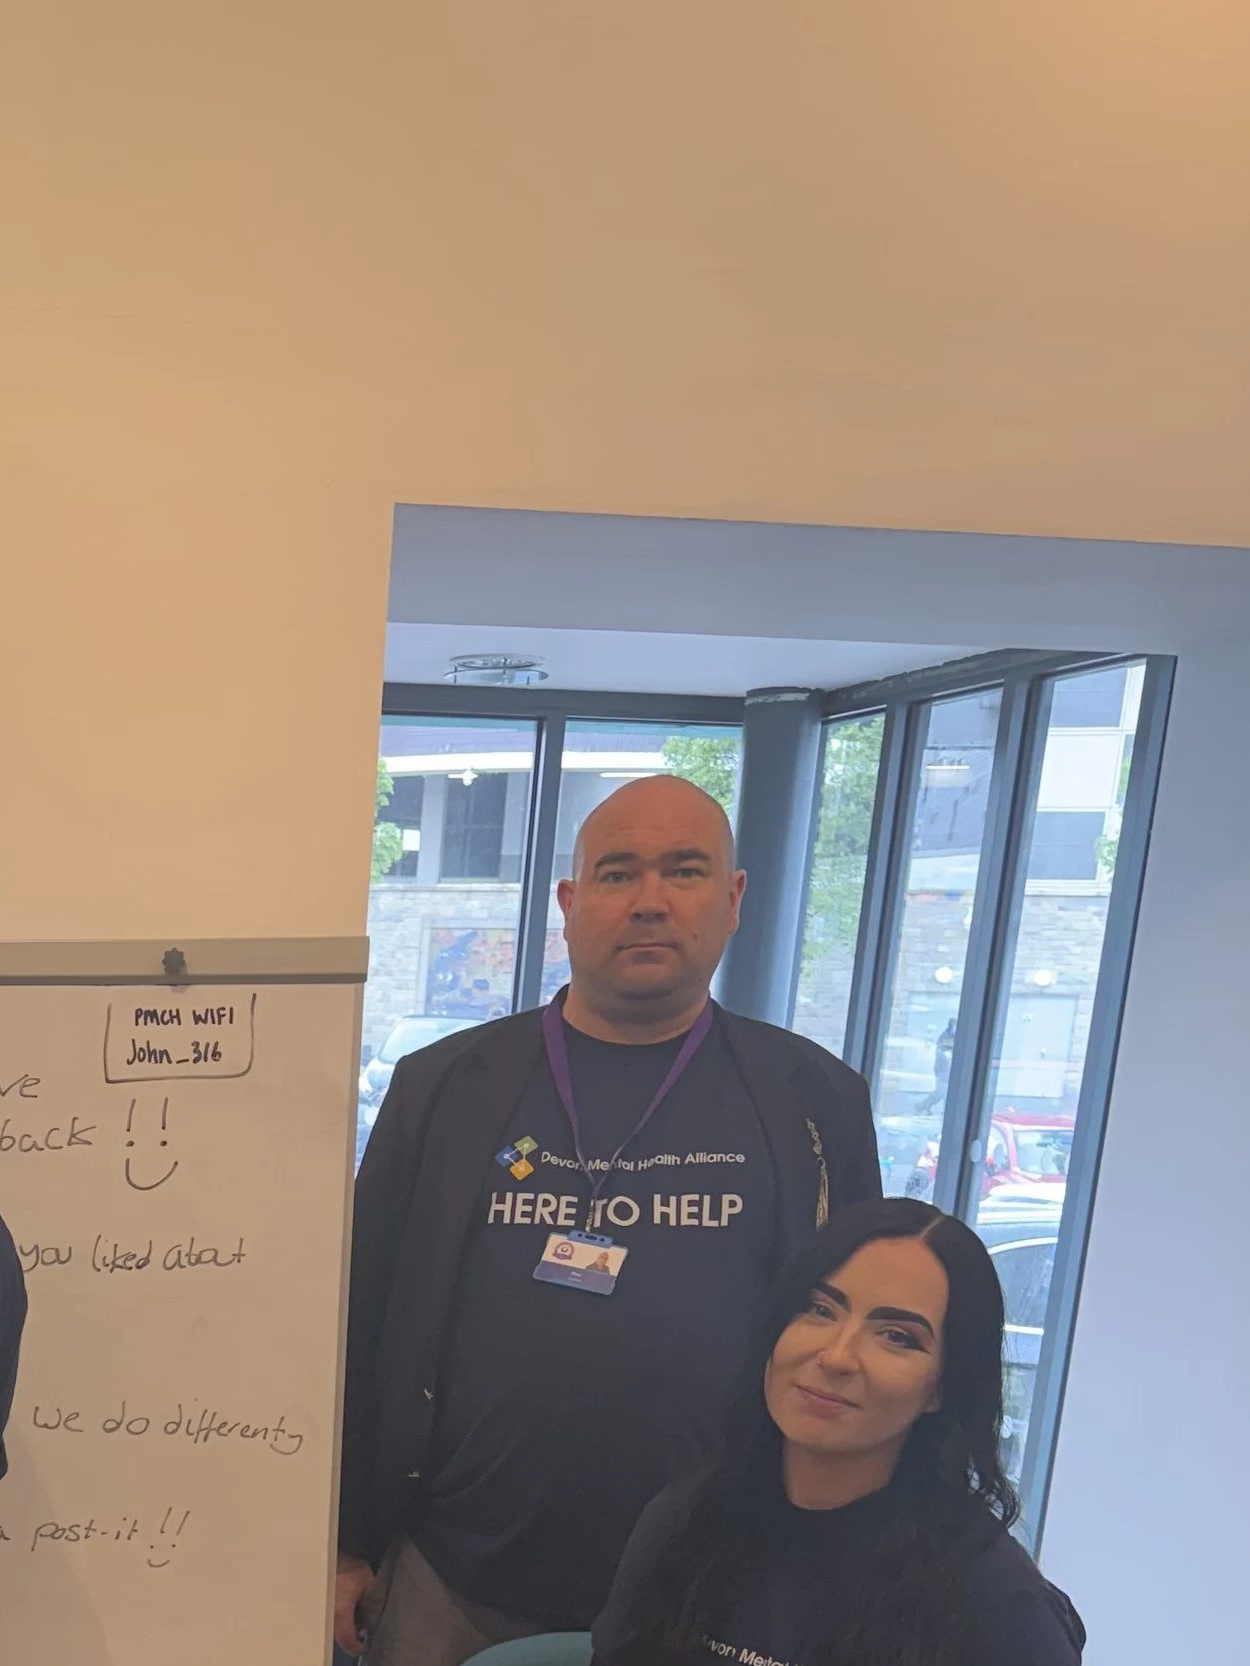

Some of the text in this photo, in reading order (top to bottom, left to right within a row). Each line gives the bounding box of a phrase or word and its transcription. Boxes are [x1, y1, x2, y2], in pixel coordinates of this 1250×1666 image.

[134, 1006, 235, 1027] PMCH WIFI
[126, 1038, 223, 1065] John_316
[684, 1151, 746, 1165] Alliance
[487, 1191, 744, 1228] HERE TO HELP
[18, 1243, 73, 1273] you
[91, 1233, 153, 1274] liked
[101, 1400, 151, 1436] do
[704, 1637, 736, 1658] von
